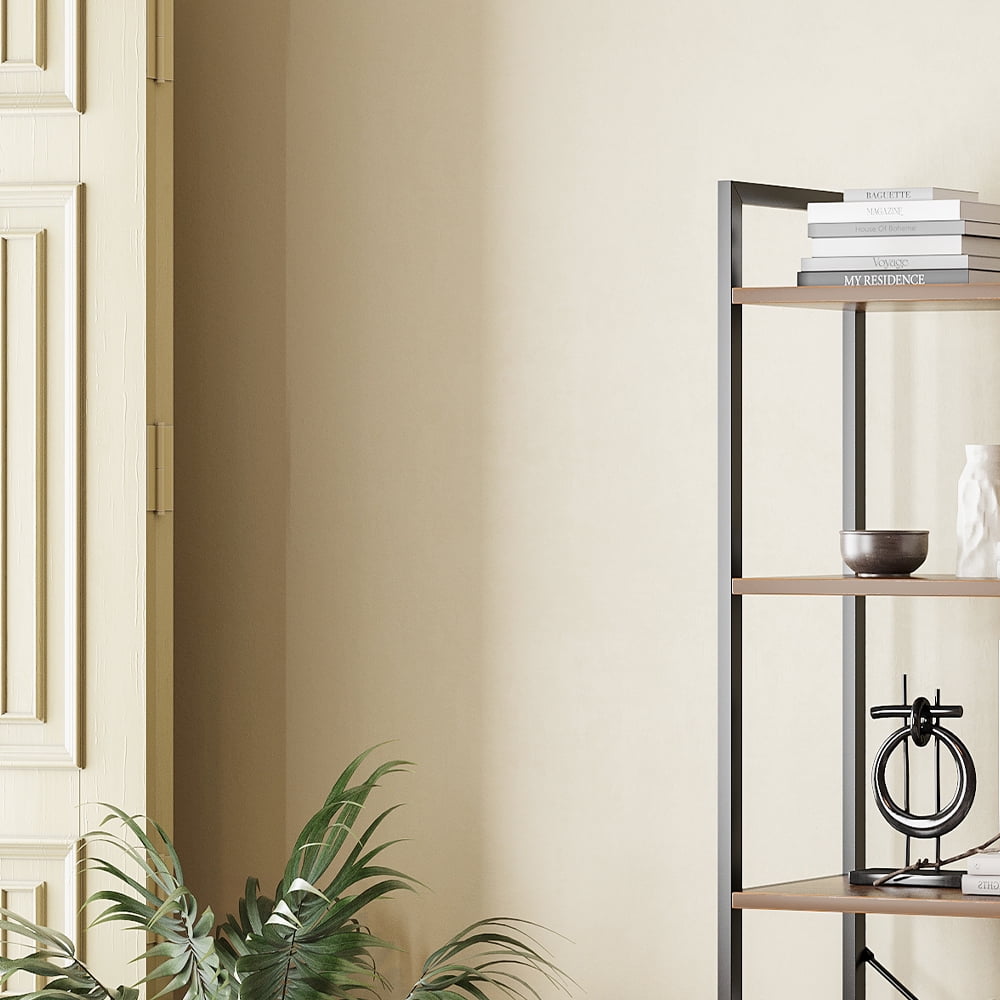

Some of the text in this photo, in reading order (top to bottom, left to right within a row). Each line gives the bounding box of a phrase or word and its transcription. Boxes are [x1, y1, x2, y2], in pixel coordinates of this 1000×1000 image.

[866, 191, 911, 199] BAGUETTE
[866, 207, 904, 216] MAGAZINE
[855, 224, 877, 233] House
[878, 223, 887, 232] Of
[873, 257, 909, 269] Voyage
[844, 274, 925, 286] MY RESIDENCE
